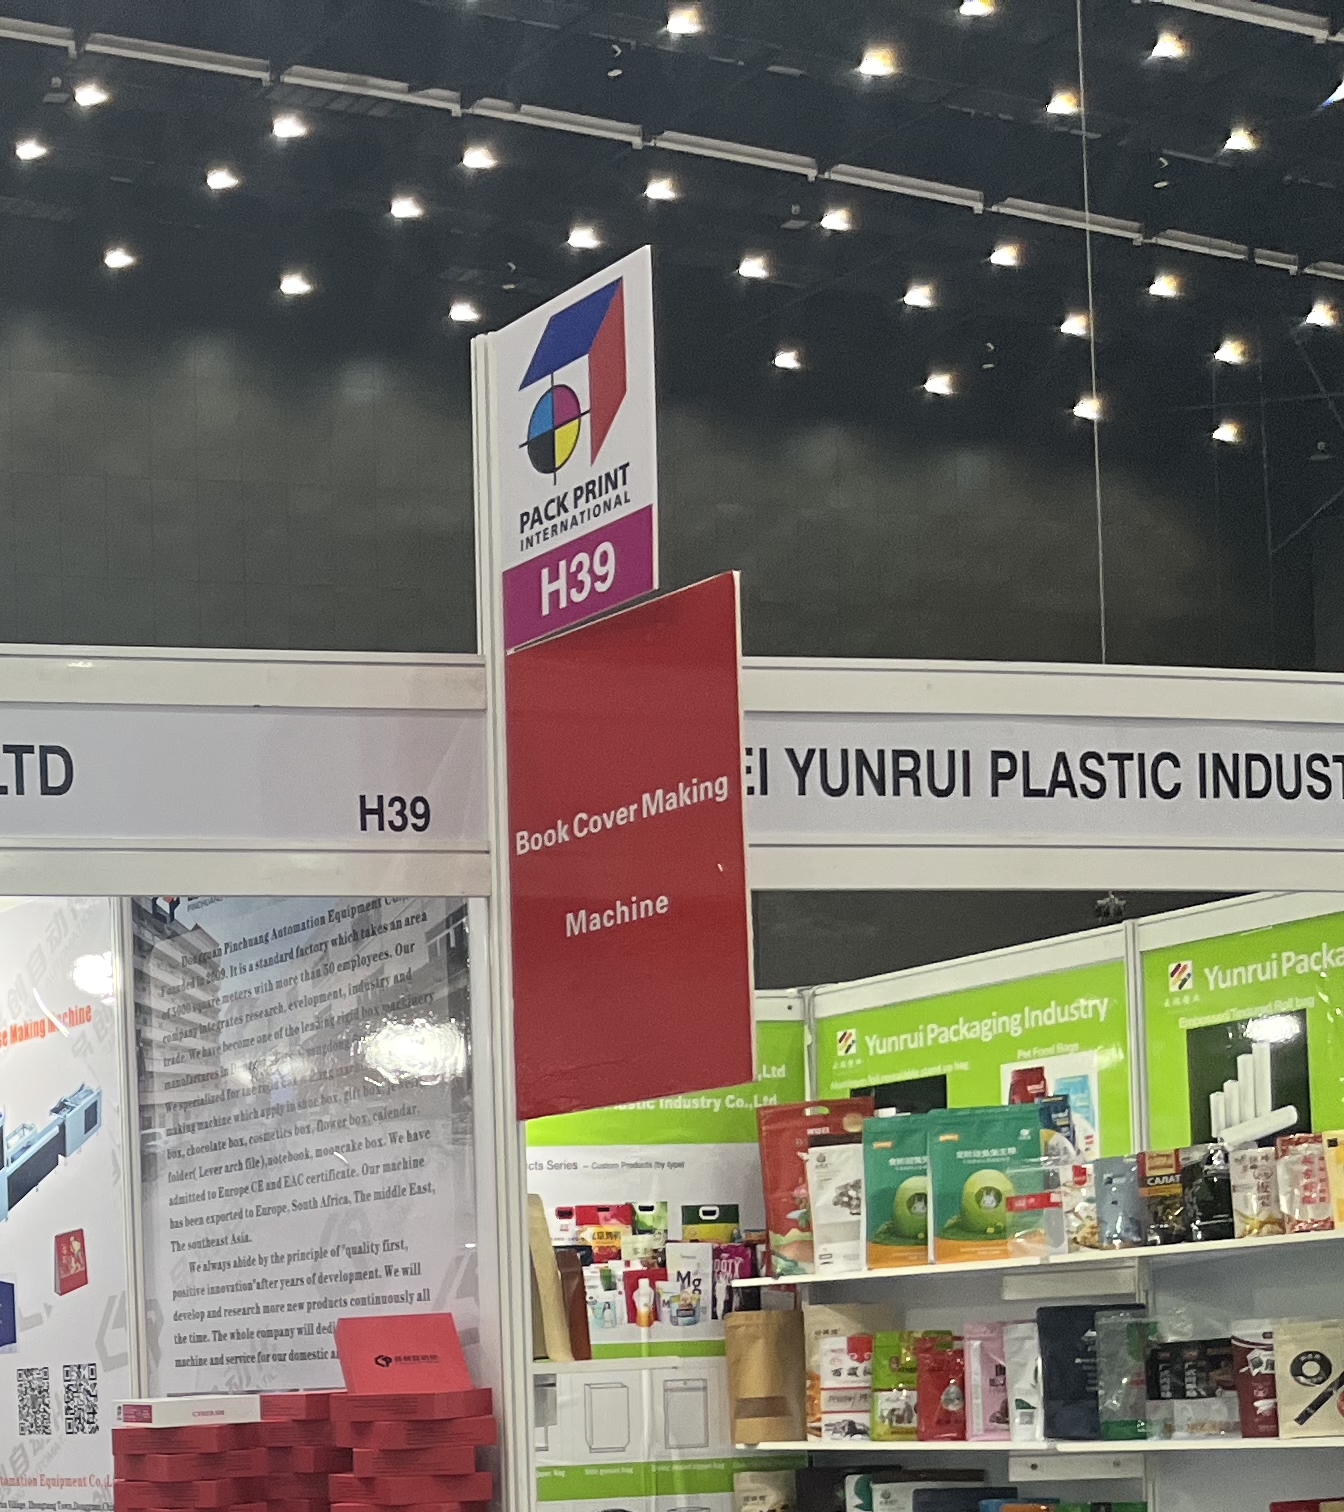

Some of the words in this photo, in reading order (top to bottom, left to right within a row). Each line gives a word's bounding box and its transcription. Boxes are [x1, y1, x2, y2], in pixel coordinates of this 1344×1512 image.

[518, 487, 567, 534] PACK
[572, 463, 631, 511] PRINT
[519, 492, 631, 552] INTERNATIONAL
[539, 541, 617, 616] H39
[785, 747, 971, 797] YUNRUI
[990, 750, 1182, 800] PLASTIC
[1198, 752, 1344, 802] INDUST
[359, 794, 430, 833] H39
[515, 814, 569, 856] Book
[573, 801, 638, 840] Cover
[642, 771, 728, 820] Making
[566, 890, 669, 937] Machine
[223, 931, 270, 955] Pinchuang
[271, 914, 326, 941] Automation
[255, 947, 294, 971] standard
[295, 939, 330, 959] factory
[404, 911, 428, 927] area
[1204, 952, 1279, 991] Yunrui
[1280, 942, 1344, 977] Packa
[10, 1017, 46, 1045] Making
[865, 1024, 924, 1056] Yunrui
[927, 1012, 1022, 1046] Packaging
[1025, 997, 1109, 1029] Industry
[659, 1096, 721, 1112] Industry
[283, 1173, 304, 1187] EAC
[305, 1166, 359, 1185] certificate.
[361, 1161, 381, 1176] Our
[382, 1155, 425, 1174] machine
[546, 1160, 579, 1171] Series
[205, 1207, 244, 1226] exported
[291, 1197, 319, 1212] South
[373, 1185, 407, 1201] middle
[408, 1181, 436, 1197] East,
[187, 1235, 229, 1251] southeast
[202, 1259, 231, 1273] always
[270, 1251, 285, 1264] the
[286, 1245, 329, 1265] principle
[382, 1238, 409, 1253] first,
[172, 1285, 206, 1302] positive
[279, 1275, 305, 1291] years
[318, 1266, 383, 1284] development.
[384, 1264, 400, 1278] We
[401, 1261, 422, 1277] will
[676, 1270, 702, 1295] Mg
[173, 1308, 206, 1322] develop
[206, 1305, 222, 1319] and
[223, 1302, 261, 1318] research
[306, 1296, 348, 1313] products
[349, 1289, 415, 1307] continuously
[416, 1287, 431, 1302] all
[211, 1329, 228, 1342] The
[229, 1327, 255, 1341] whole
[256, 1326, 295, 1341] company
[296, 1322, 314, 1336] will
[174, 1354, 208, 1368] machine
[209, 1353, 225, 1366] and
[225, 1352, 256, 1365] service
[288, 1348, 329, 1362] domestic
